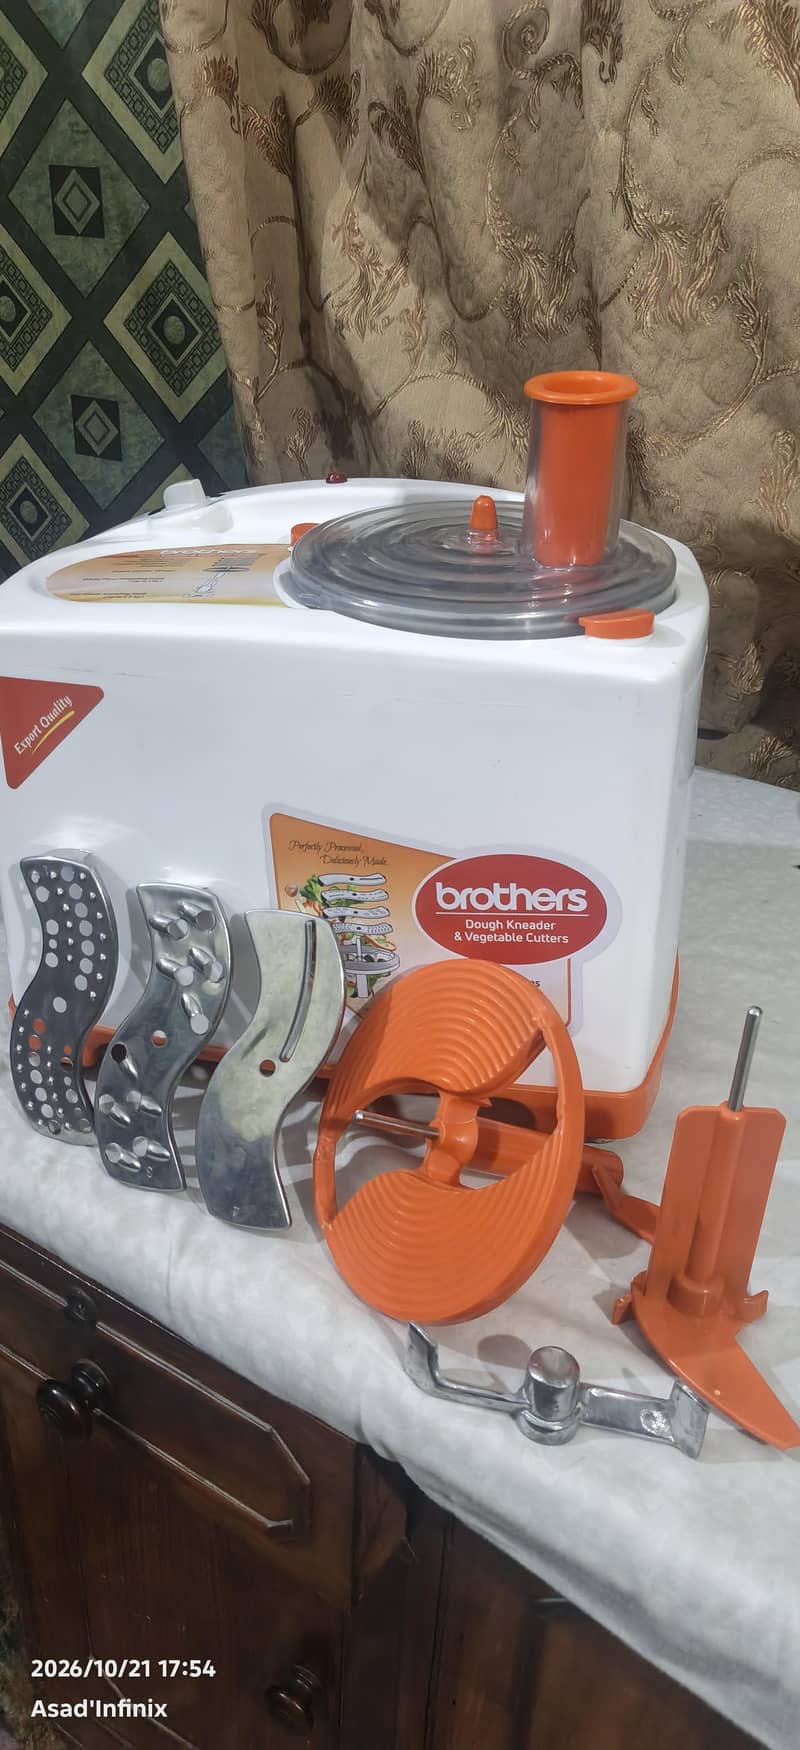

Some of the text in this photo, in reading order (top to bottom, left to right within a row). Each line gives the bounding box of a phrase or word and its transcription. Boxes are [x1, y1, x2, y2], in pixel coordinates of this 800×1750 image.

[14, 695, 73, 755] Export Quality
[435, 881, 588, 912] brothers
[465, 919, 556, 931] Dough Kneader
[454, 931, 569, 944] & Vegetable Cutters
